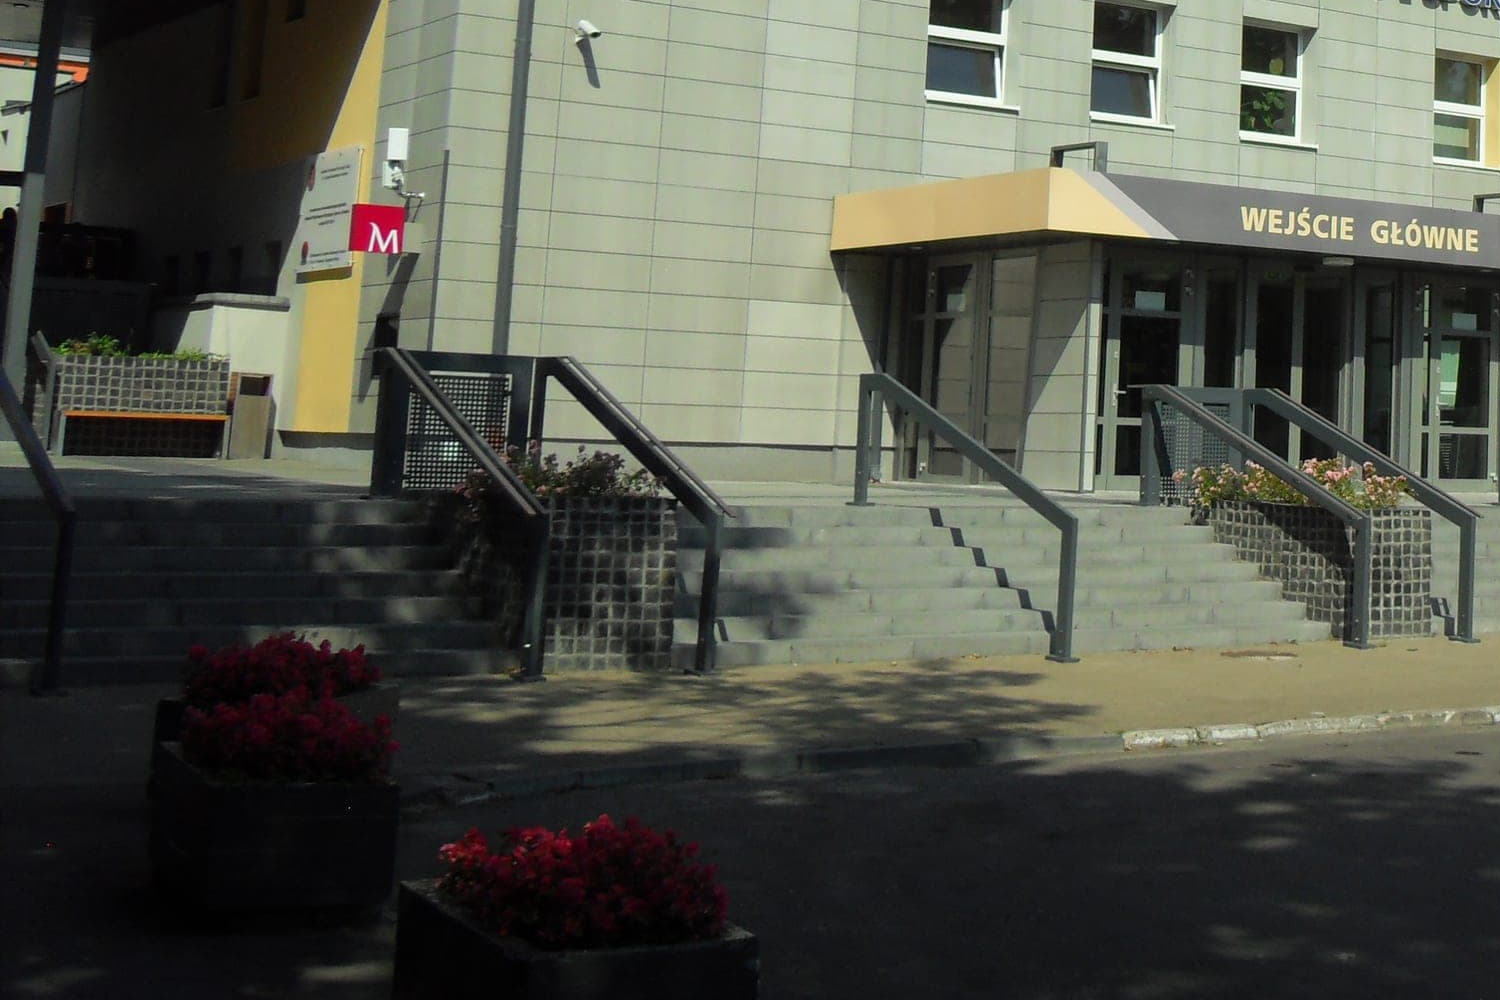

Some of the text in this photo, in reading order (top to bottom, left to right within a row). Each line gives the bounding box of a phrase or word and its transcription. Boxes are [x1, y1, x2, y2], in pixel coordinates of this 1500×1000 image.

[367, 222, 399, 254] M
[1240, 206, 1480, 252] WEJŚCIE GŁÓWNE
